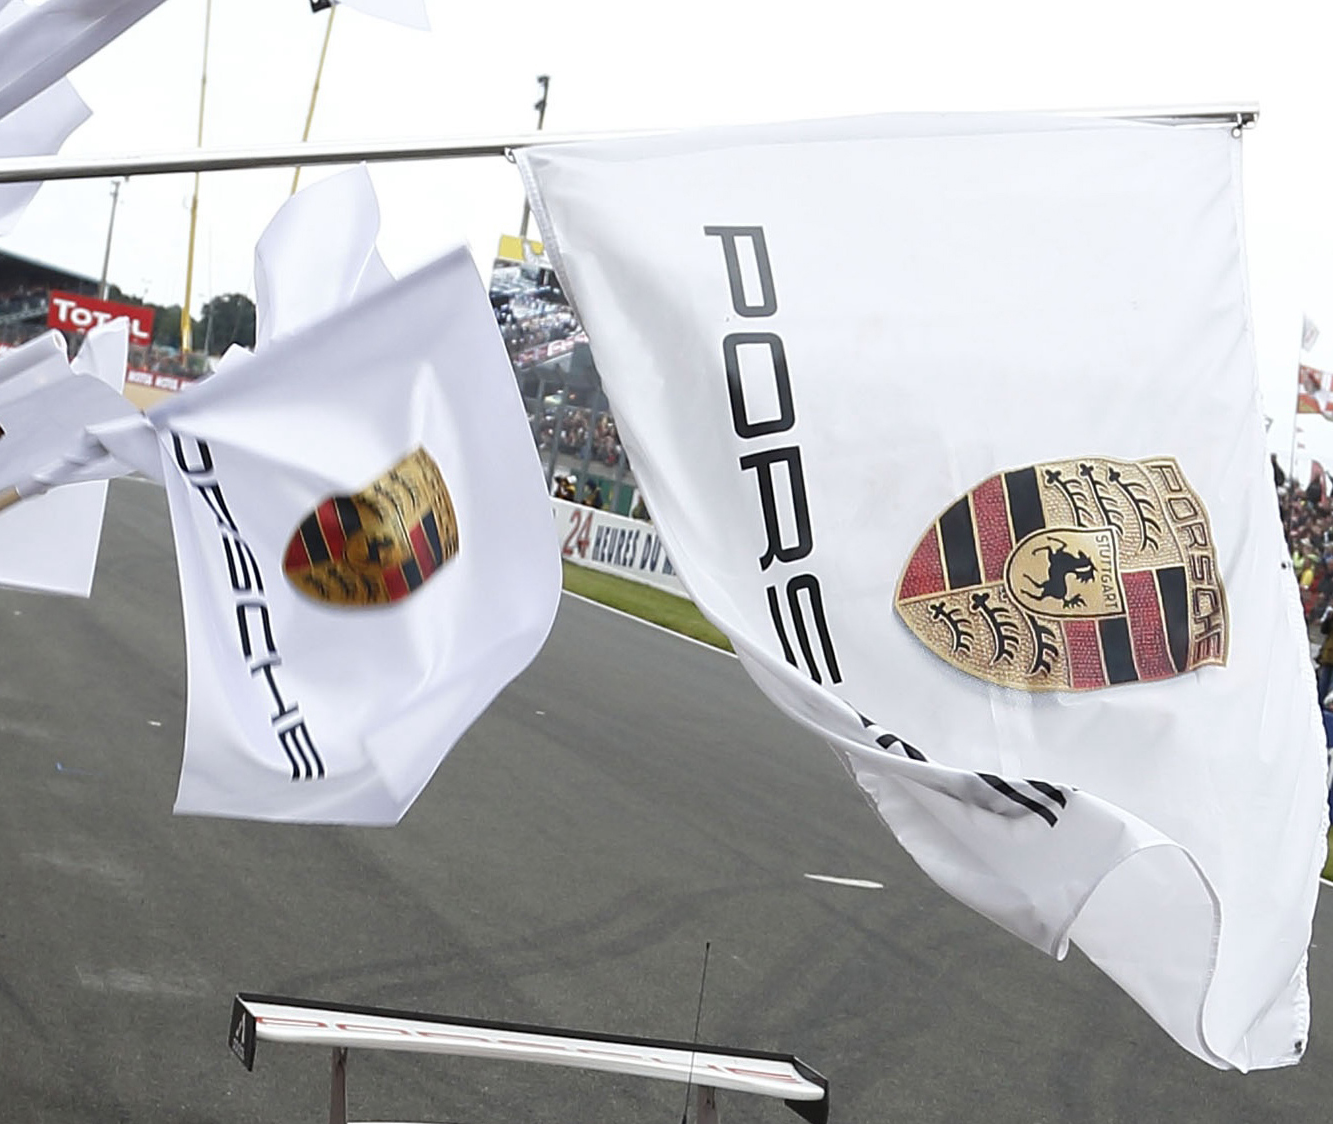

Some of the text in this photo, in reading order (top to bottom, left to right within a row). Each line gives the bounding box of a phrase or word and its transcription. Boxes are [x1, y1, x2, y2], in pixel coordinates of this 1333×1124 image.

[53, 298, 150, 338] TOTL
[563, 510, 594, 558] 24
[592, 525, 640, 568] HEURES
[640, 534, 662, 572] DU
[1095, 534, 1118, 609] STUTTGART
[1150, 464, 1224, 666] PORSCHE
[171, 431, 325, 782] ORSCHE
